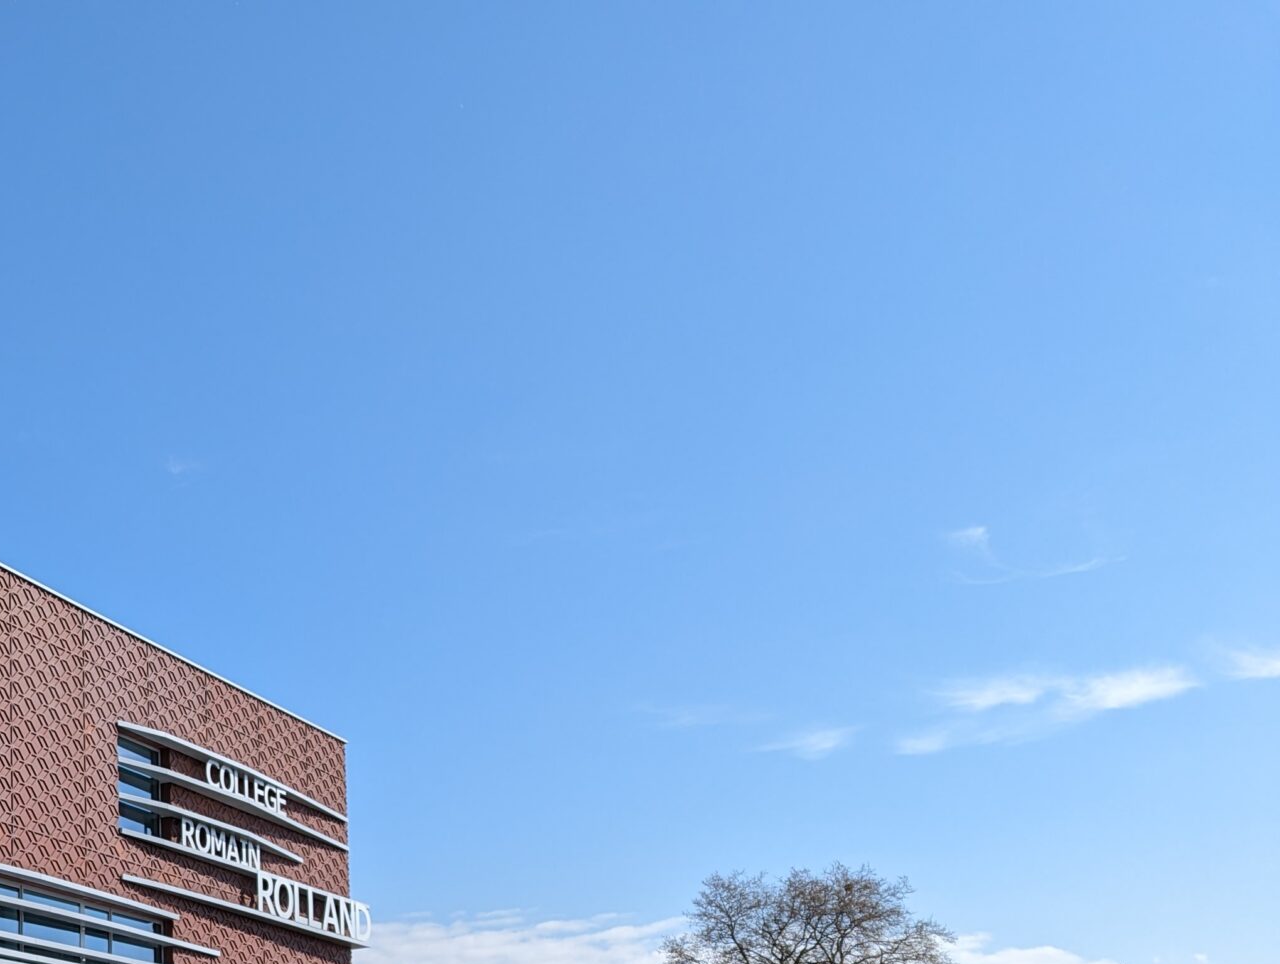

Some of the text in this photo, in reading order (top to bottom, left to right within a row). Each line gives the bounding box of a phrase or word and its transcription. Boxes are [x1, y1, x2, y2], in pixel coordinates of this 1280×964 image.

[205, 759, 287, 816] COLLEGE
[180, 817, 261, 871] ROMAIN
[257, 870, 371, 942] ROLLAND
